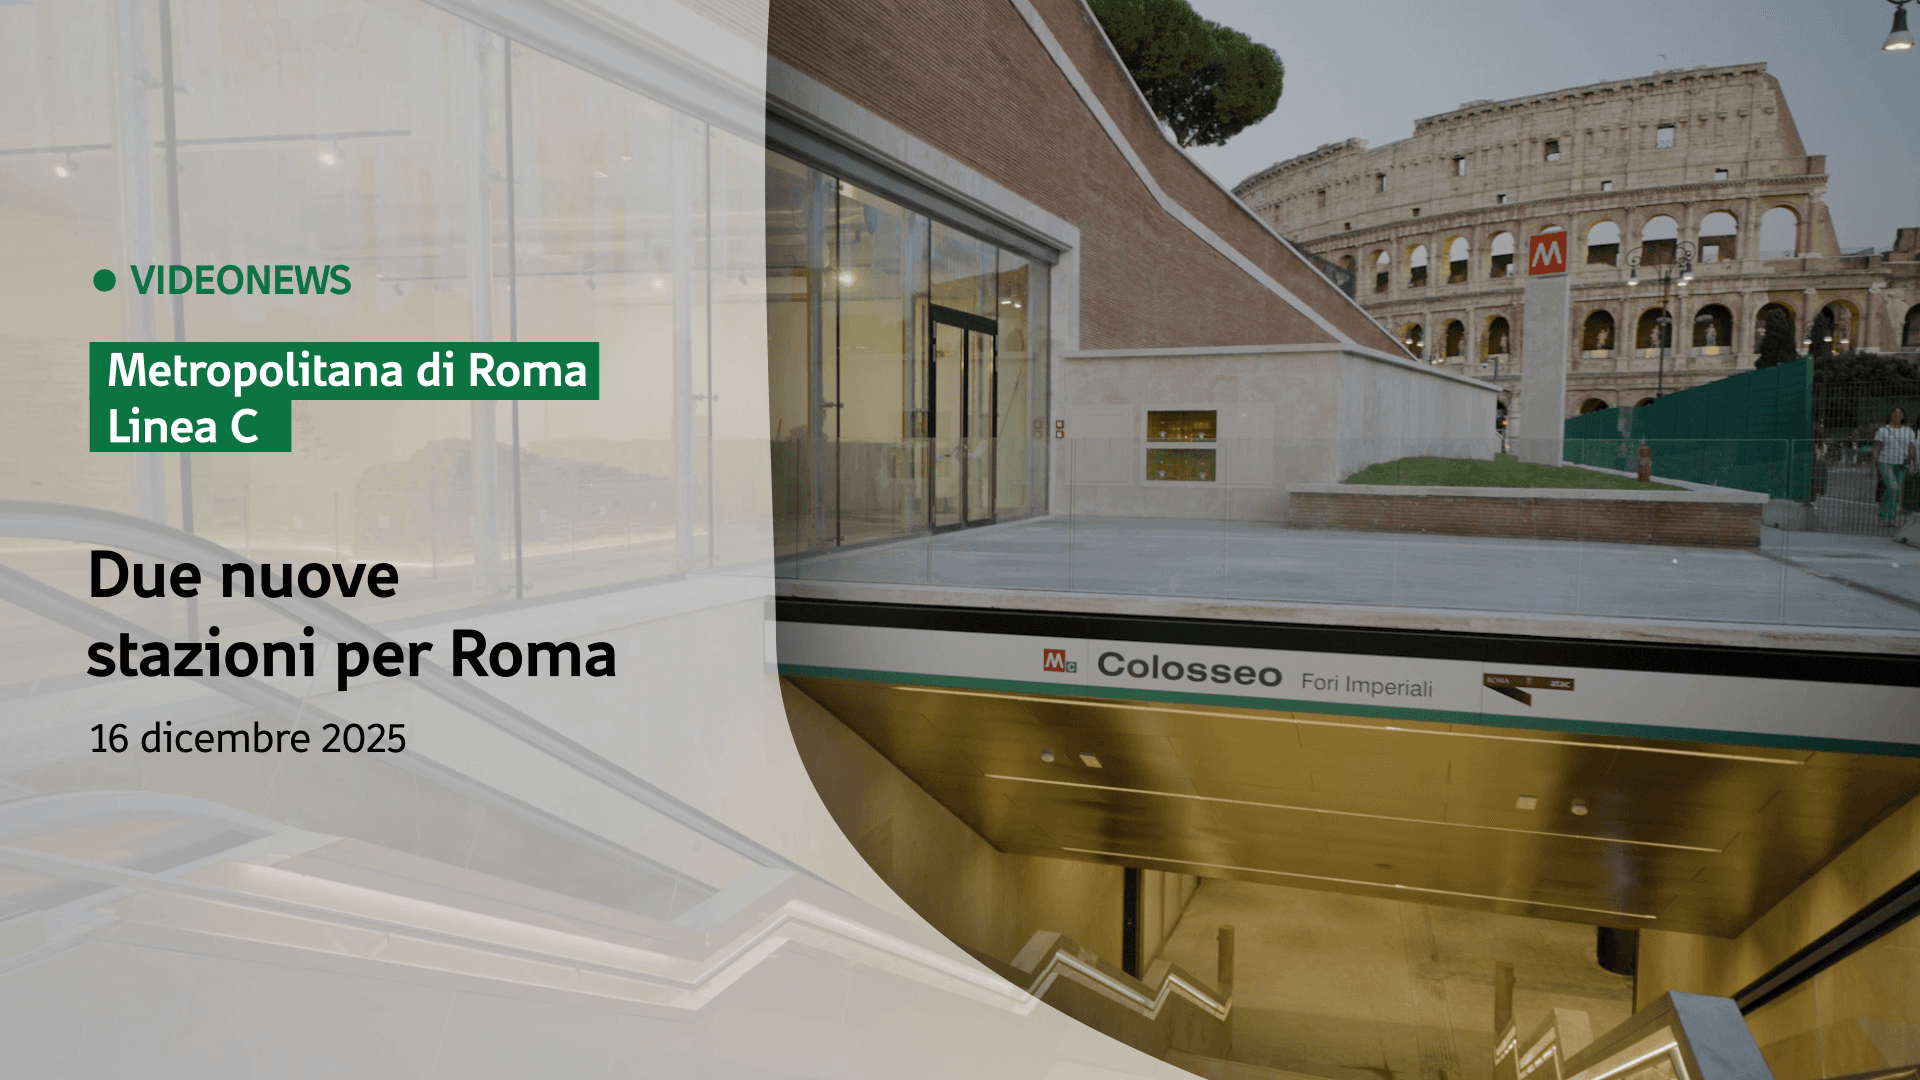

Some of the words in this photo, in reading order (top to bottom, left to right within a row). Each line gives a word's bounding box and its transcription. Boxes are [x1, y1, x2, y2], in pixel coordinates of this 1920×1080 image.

[1531, 239, 1563, 268] M
[1044, 651, 1065, 669] M
[1098, 651, 1283, 687] Colosseo
[1302, 673, 1338, 691] Fori
[1346, 675, 1433, 698] Imperiali
[1549, 680, 1571, 688] atac
